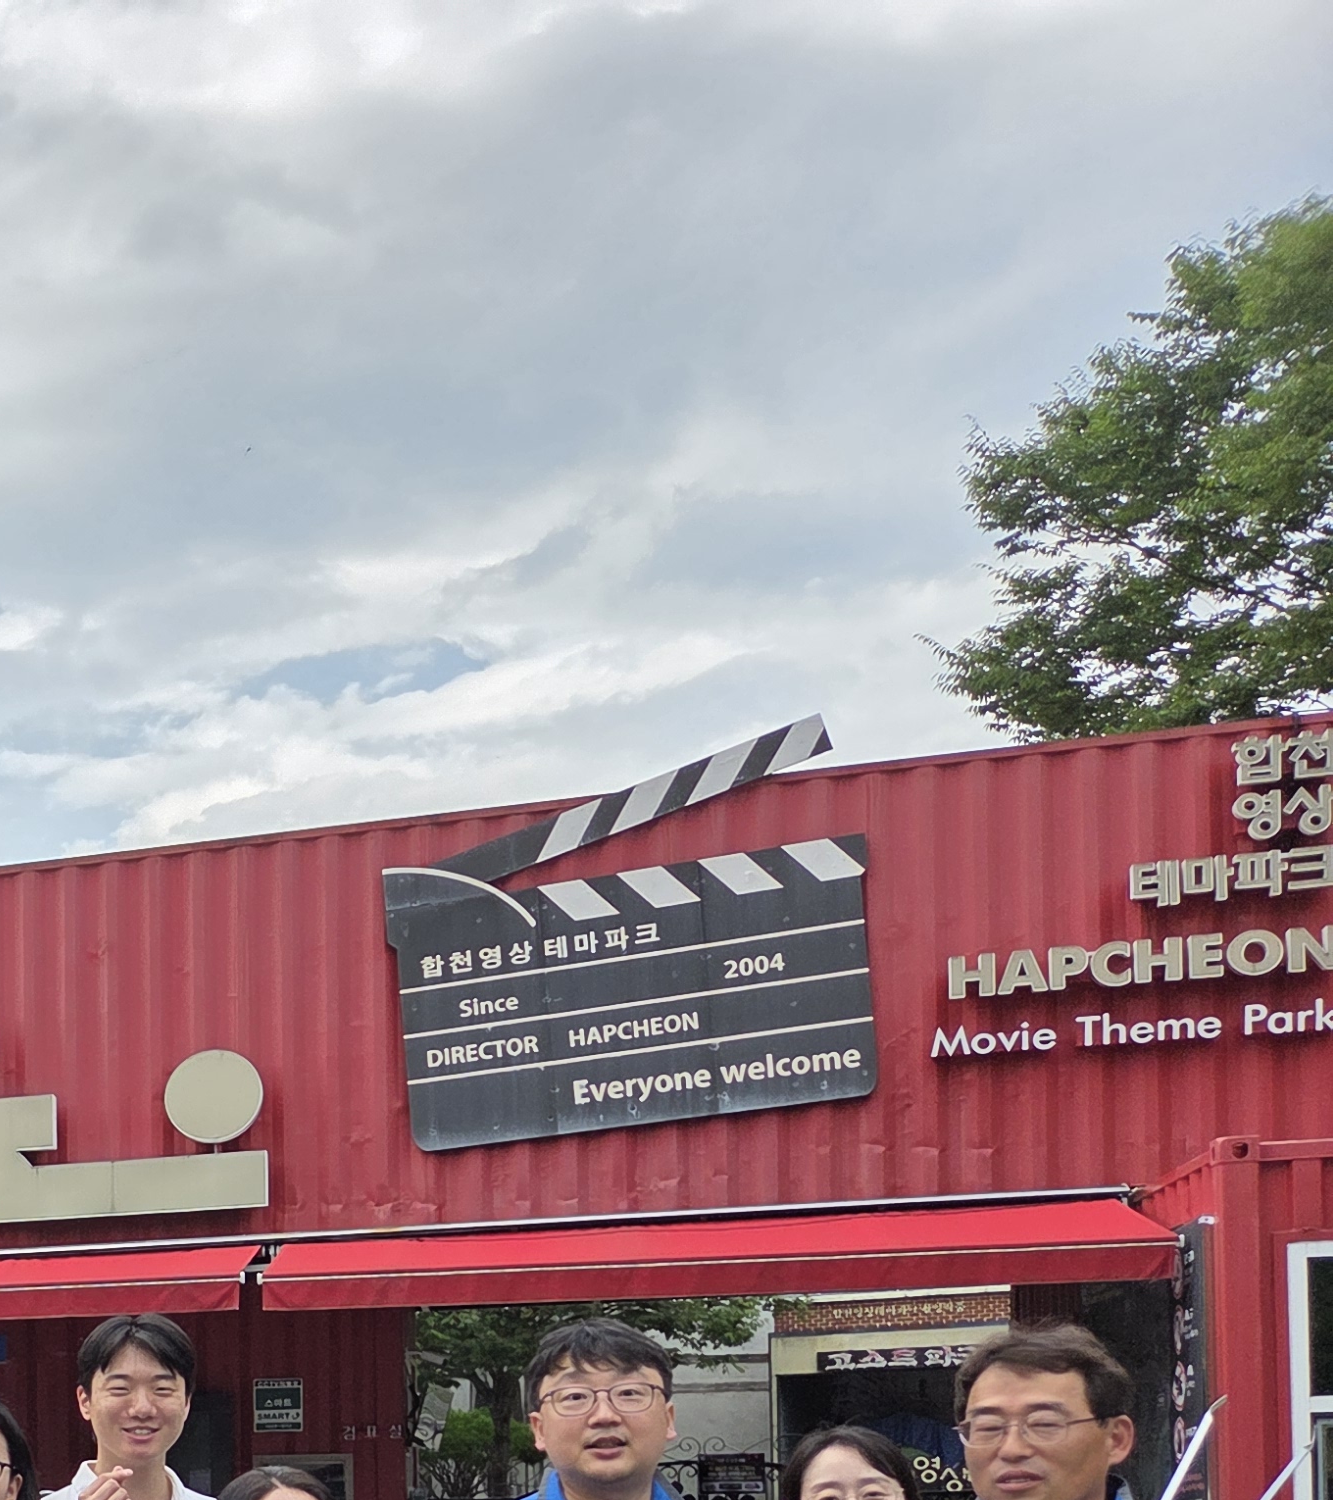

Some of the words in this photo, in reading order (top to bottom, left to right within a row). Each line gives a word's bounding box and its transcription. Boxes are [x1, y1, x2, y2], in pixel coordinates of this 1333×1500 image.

[1231, 728, 1333, 787] 합천
[1231, 783, 1333, 841] 영상
[1129, 844, 1333, 908] 테마파크
[419, 940, 533, 979] 합천영상
[543, 922, 661, 960] 테마파크
[947, 924, 1333, 1000] HAPCHEON
[458, 994, 520, 1019] Since
[723, 952, 786, 980] 2004
[425, 1034, 540, 1069] DIRECTOR
[567, 1011, 701, 1048] HAPCHEON
[930, 1020, 1058, 1058] Movie
[1075, 1012, 1223, 1048] Theme
[1243, 997, 1333, 1036] Park
[571, 1064, 712, 1106] Everyone
[719, 1047, 862, 1085] welcome
[824, 1349, 919, 1371] 고스트
[257, 1411, 291, 1421] SMART
[913, 1454, 972, 1492] 영상
